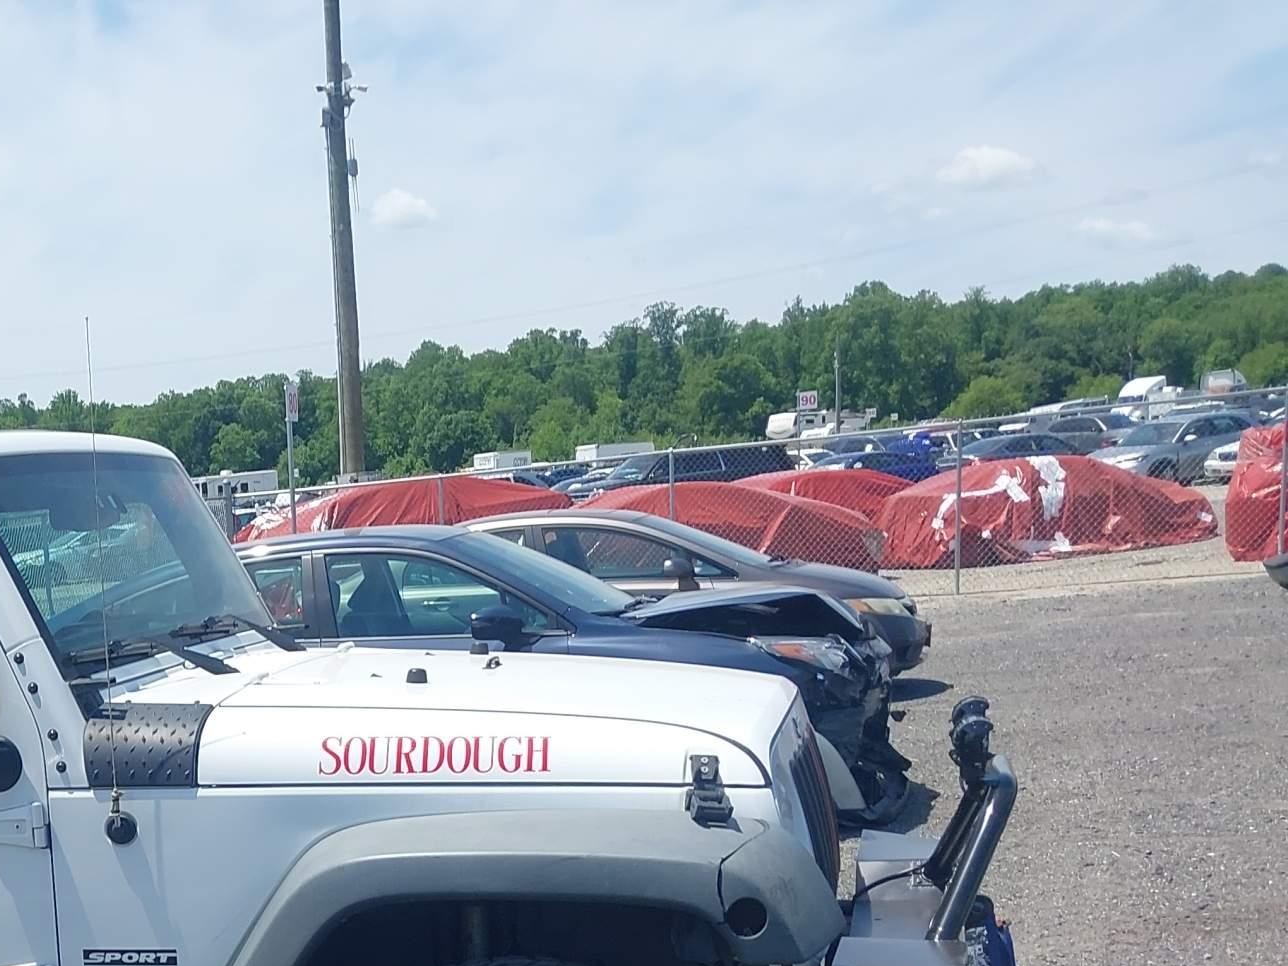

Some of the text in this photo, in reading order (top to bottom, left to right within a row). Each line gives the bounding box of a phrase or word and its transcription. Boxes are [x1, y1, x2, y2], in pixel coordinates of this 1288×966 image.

[288, 391, 297, 414] 80
[800, 394, 817, 406] 90
[318, 735, 551, 775] SOURDOUGH
[83, 952, 177, 964] SPORT
